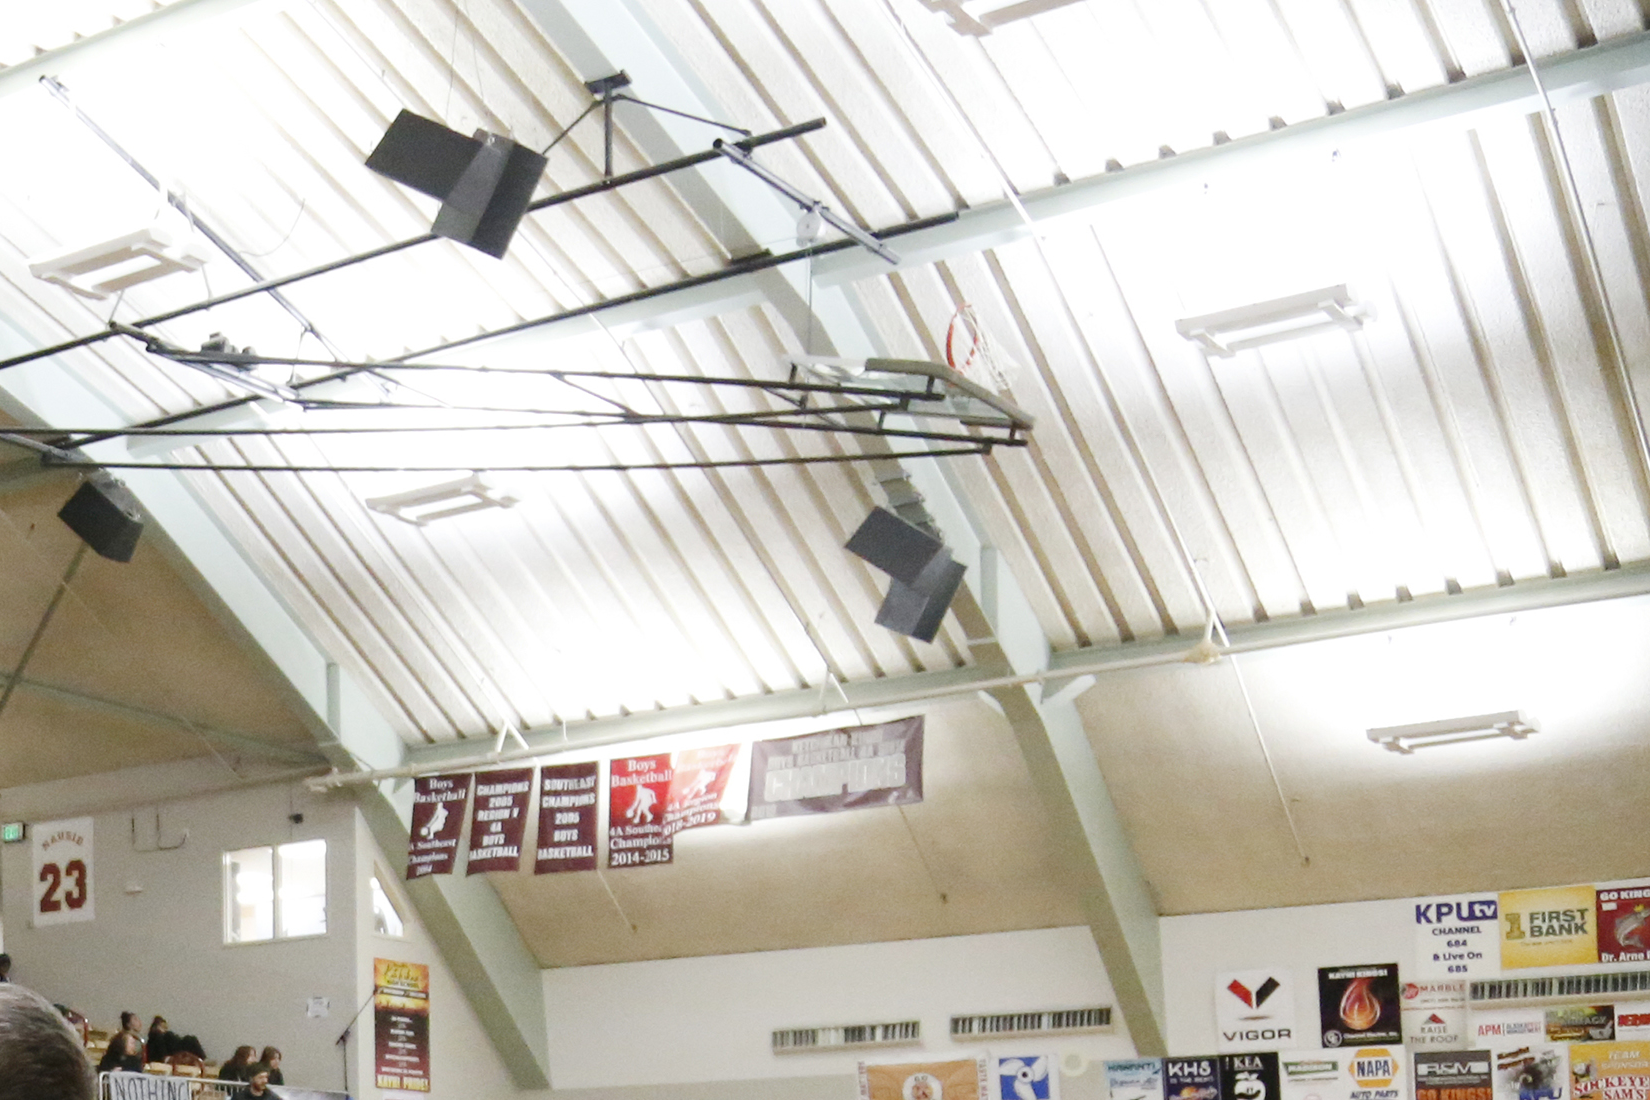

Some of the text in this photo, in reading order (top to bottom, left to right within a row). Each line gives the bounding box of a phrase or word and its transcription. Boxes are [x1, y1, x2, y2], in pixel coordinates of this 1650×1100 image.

[628, 759, 656, 773] Boys
[429, 778, 454, 791] Boys
[611, 770, 672, 787] Basketball
[477, 781, 529, 796] CHAMPIONS
[542, 793, 596, 808] CHAMPIONS
[477, 808, 510, 821] REGION
[663, 811, 717, 835] 018-2019
[553, 829, 579, 842] BOYS
[610, 826, 623, 837] 4A
[482, 834, 506, 846] BOYS
[611, 849, 670, 866] 2014-2015
[40, 860, 87, 913] 23
[1600, 889, 1650, 901] GO KING
[1529, 908, 1589, 924] FIRST
[1432, 926, 1482, 936] CHANNEL
[1530, 922, 1589, 938] BANK
[1443, 952, 1464, 961] Live
[1468, 951, 1482, 960] On
[1601, 951, 1644, 962] Dr. Arne
[1420, 983, 1465, 993] MARBLE
[1222, 1028, 1292, 1042] VIGOR
[1478, 1024, 1501, 1036] APM
[1410, 1035, 1458, 1044] THE ROOF
[1168, 1061, 1211, 1076] KHS
[1234, 1057, 1263, 1070] KEA
[1356, 1059, 1391, 1076] NAPA
[1574, 1076, 1650, 1096] SOCKEYE
[1350, 1090, 1398, 1100] AUTO PARTS
